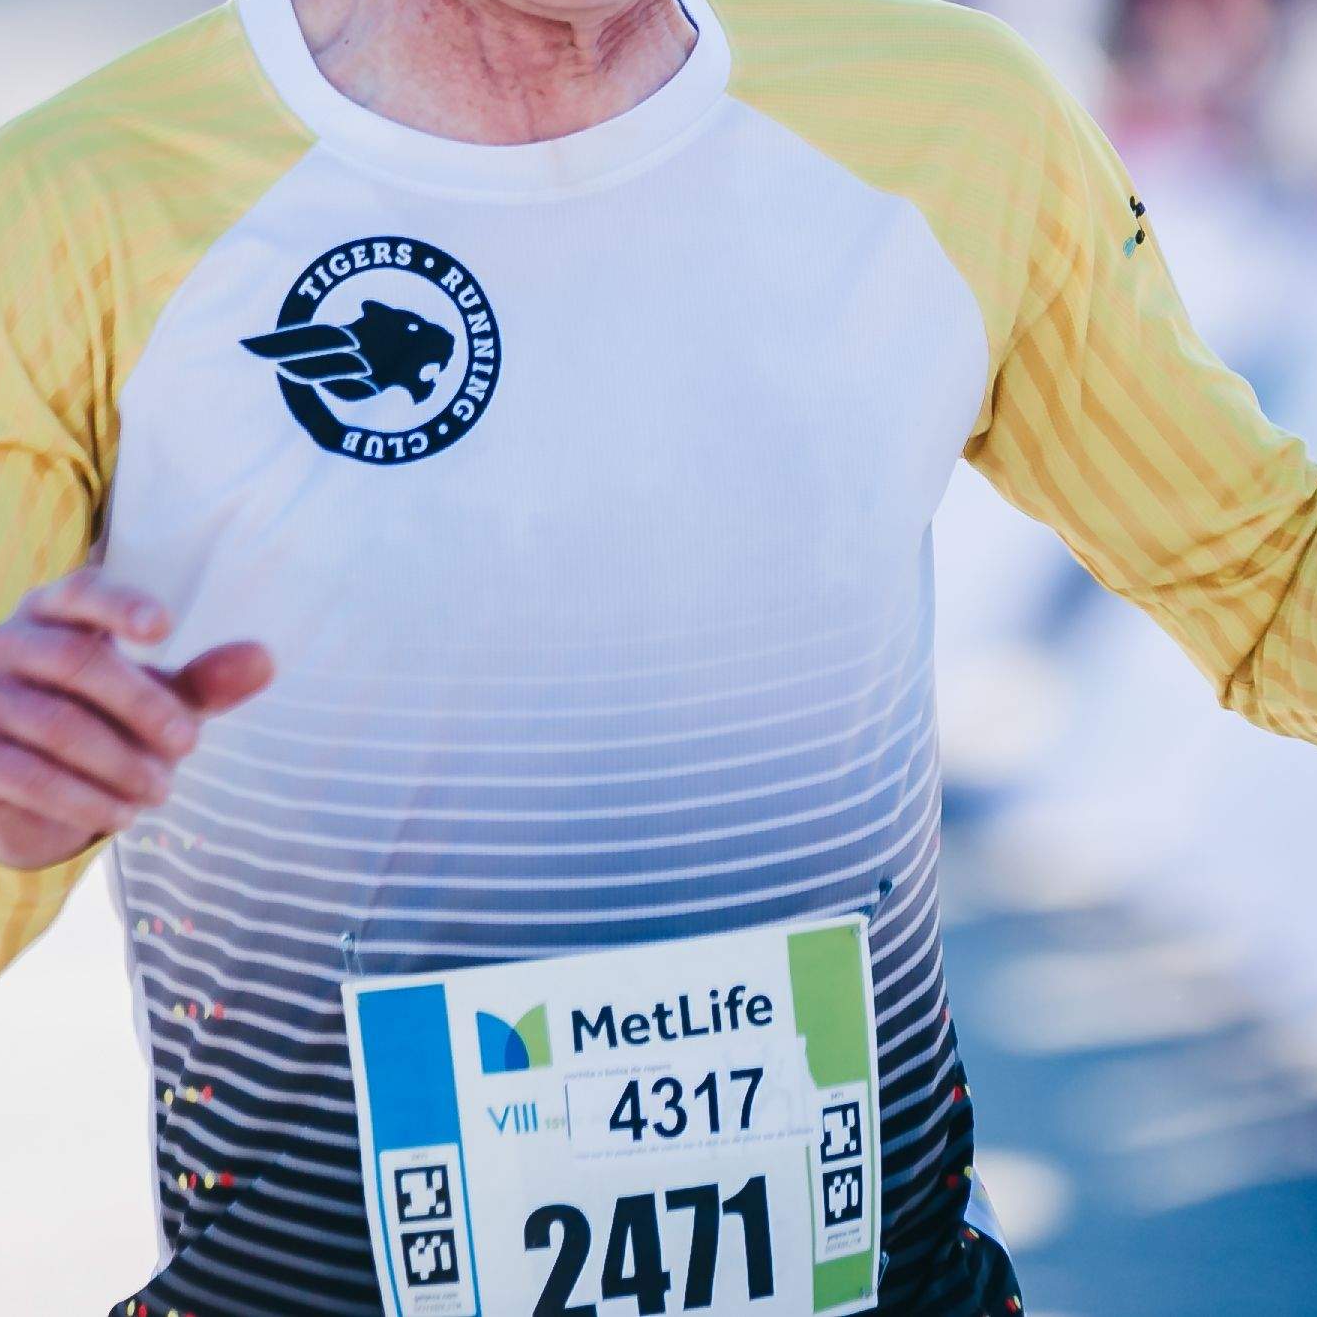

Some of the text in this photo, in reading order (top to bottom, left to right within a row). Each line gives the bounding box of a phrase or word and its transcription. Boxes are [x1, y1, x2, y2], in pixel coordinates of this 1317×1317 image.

[297, 242, 495, 459] TIGERS RUNNING CLUB
[571, 985, 773, 1053] MetLife
[486, 1101, 539, 1135] VIII
[609, 1067, 764, 1141] 4317
[523, 1175, 775, 1317] 2471
